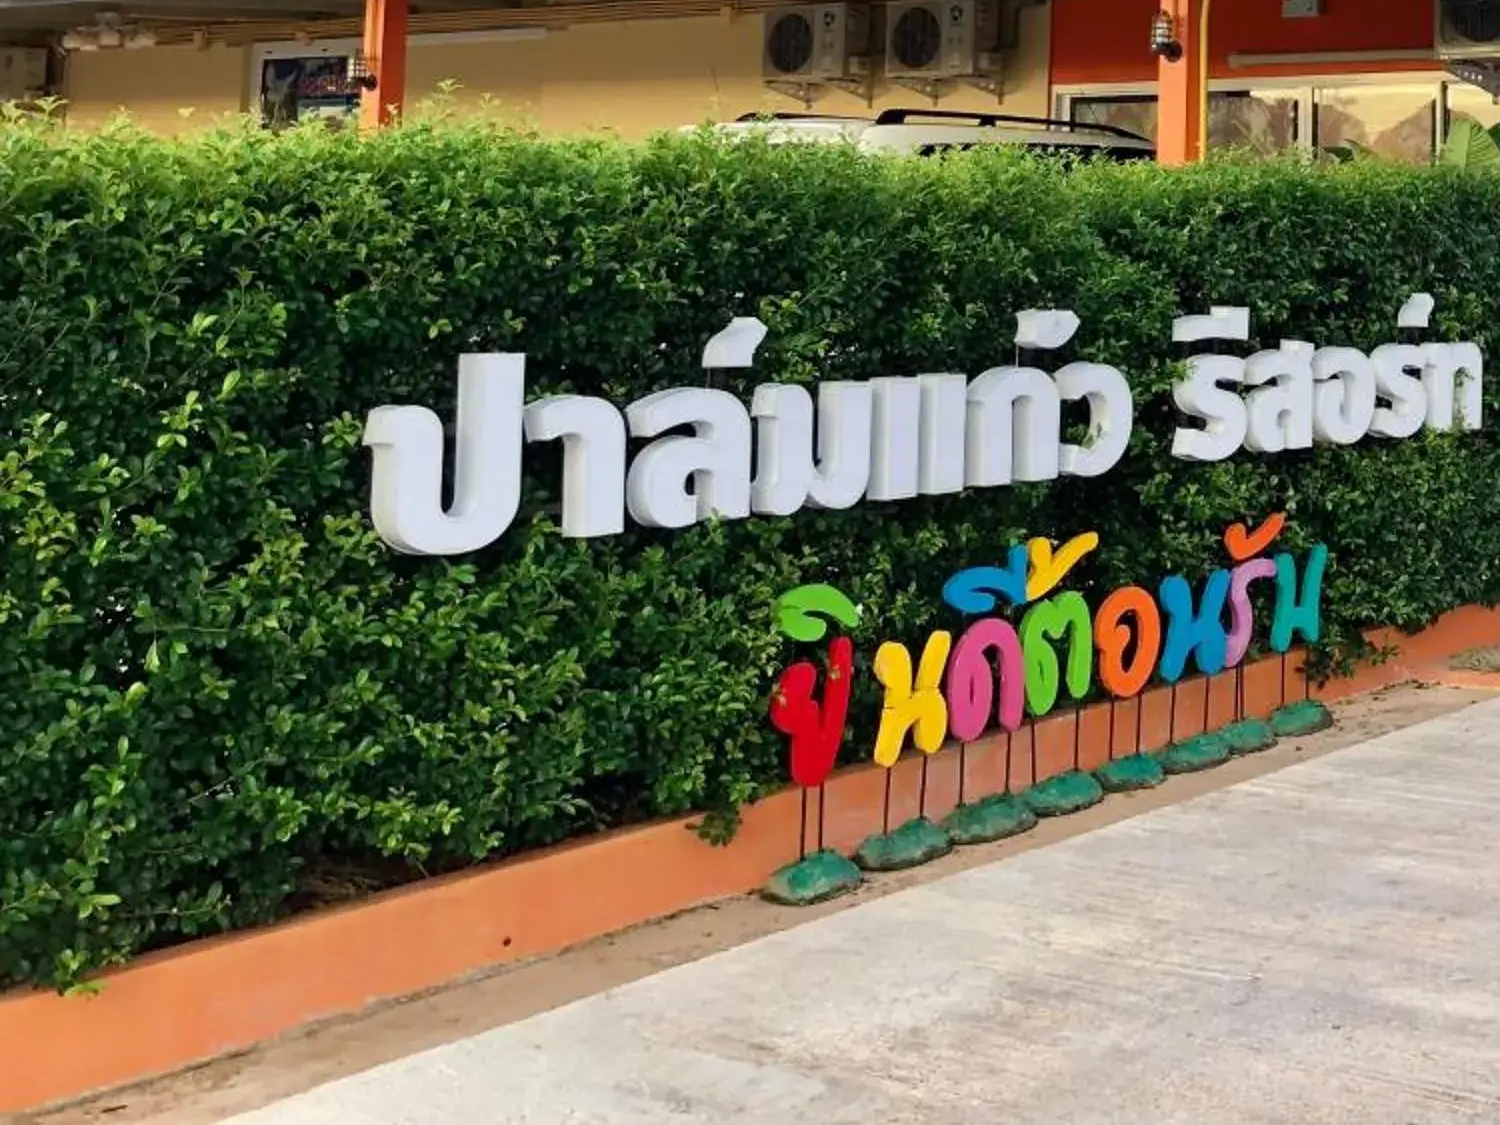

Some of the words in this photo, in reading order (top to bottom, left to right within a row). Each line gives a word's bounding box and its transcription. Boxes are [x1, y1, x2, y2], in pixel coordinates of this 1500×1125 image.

[362, 309, 1132, 555] ปาล์มแก้ว
[1172, 292, 1483, 461] รีสอร์ท
